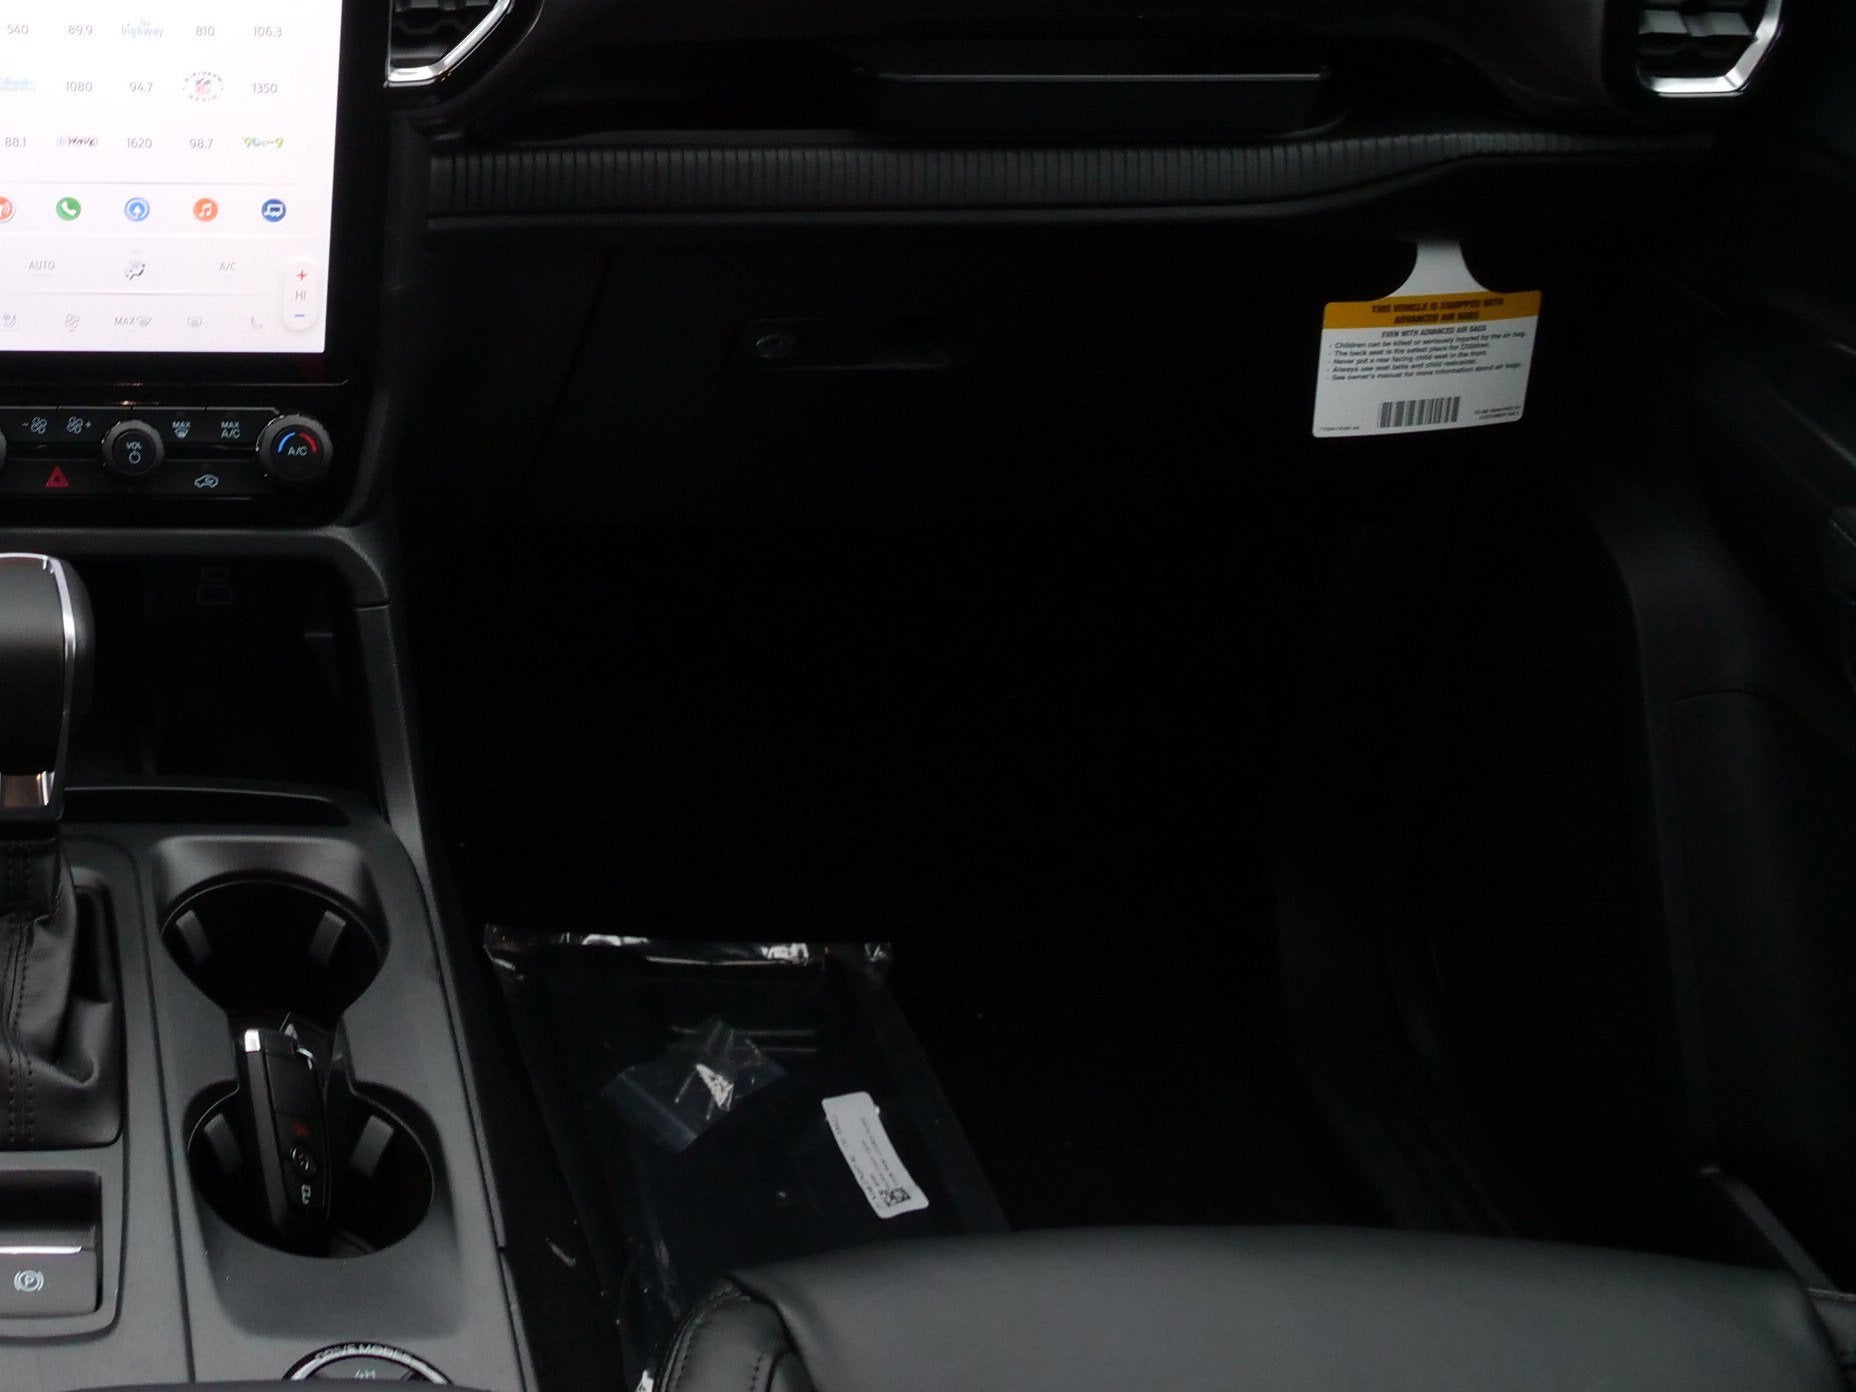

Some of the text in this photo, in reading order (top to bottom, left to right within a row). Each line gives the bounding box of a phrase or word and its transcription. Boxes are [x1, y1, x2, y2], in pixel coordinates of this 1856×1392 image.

[6, 24, 29, 36] 540
[68, 24, 94, 37] 89.9
[195, 25, 215, 37] 810
[253, 26, 283, 38] 106.3
[65, 81, 93, 93] 1080
[128, 81, 153, 93] 94.7
[252, 82, 278, 94] 1350
[4, 137, 27, 148] 88.1
[126, 137, 153, 149] 1620
[189, 138, 214, 150] 98.7
[221, 421, 240, 429] MAX
[220, 428, 241, 439] A/C
[125, 441, 143, 450] VOL
[287, 446, 308, 457] A/C
